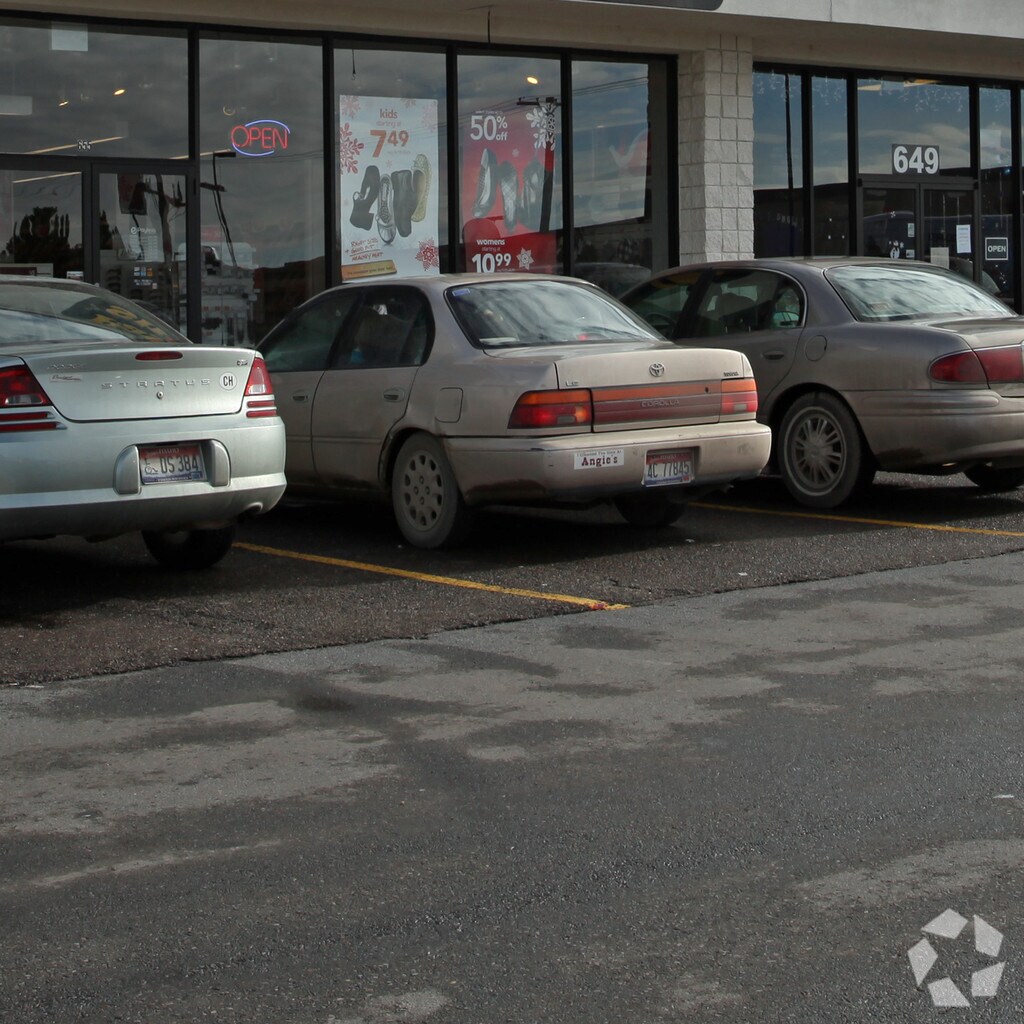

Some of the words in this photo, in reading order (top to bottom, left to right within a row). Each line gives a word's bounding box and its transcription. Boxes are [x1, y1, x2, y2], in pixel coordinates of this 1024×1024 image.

[379, 108, 398, 119] kids
[470, 115, 508, 141] 50%
[230, 125, 288, 149] OPEN
[495, 132, 508, 141] off
[77, 140, 92, 152] 655
[893, 145, 939, 174] 649
[987, 245, 1007, 253] OPEN
[101, 378, 212, 390] STRATUS
[223, 376, 233, 387] CH
[641, 398, 680, 408] COROLLA
[581, 454, 618, 468] Angie's
